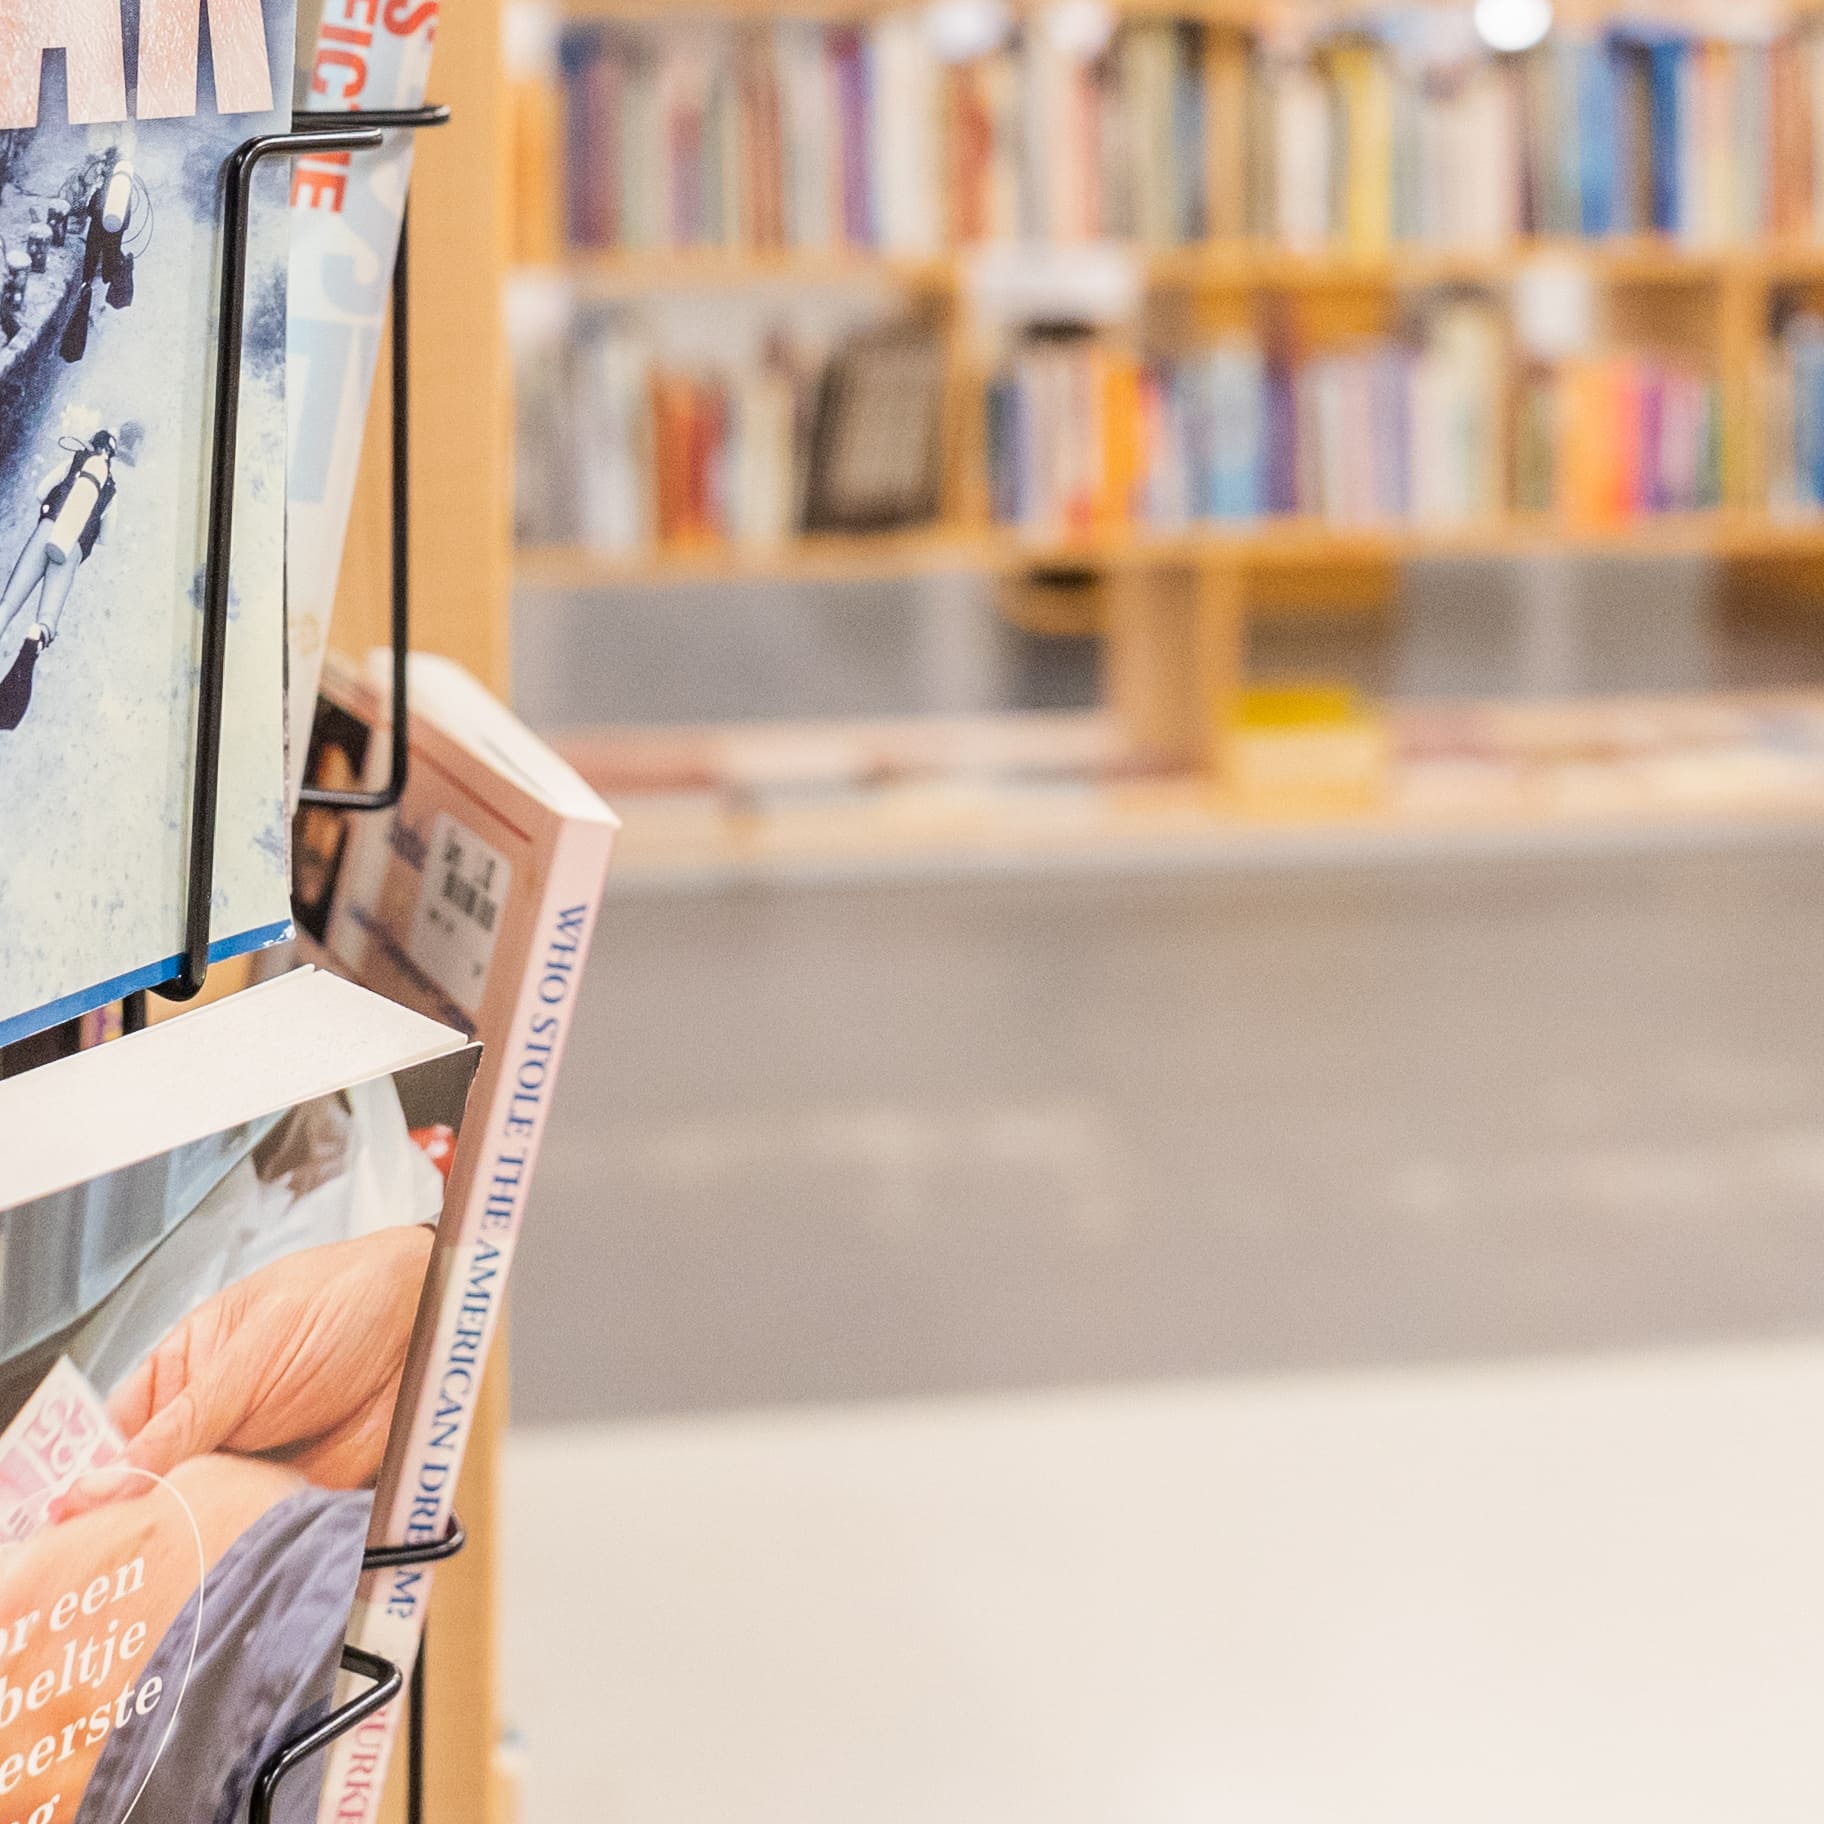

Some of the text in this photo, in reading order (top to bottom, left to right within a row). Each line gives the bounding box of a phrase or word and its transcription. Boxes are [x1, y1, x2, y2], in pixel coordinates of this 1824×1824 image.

[385, 902, 588, 1622] WHO STOLE THE AMERICAN DREM?
[49, 1556, 146, 1634] een
[335, 1710, 389, 1824] URK
